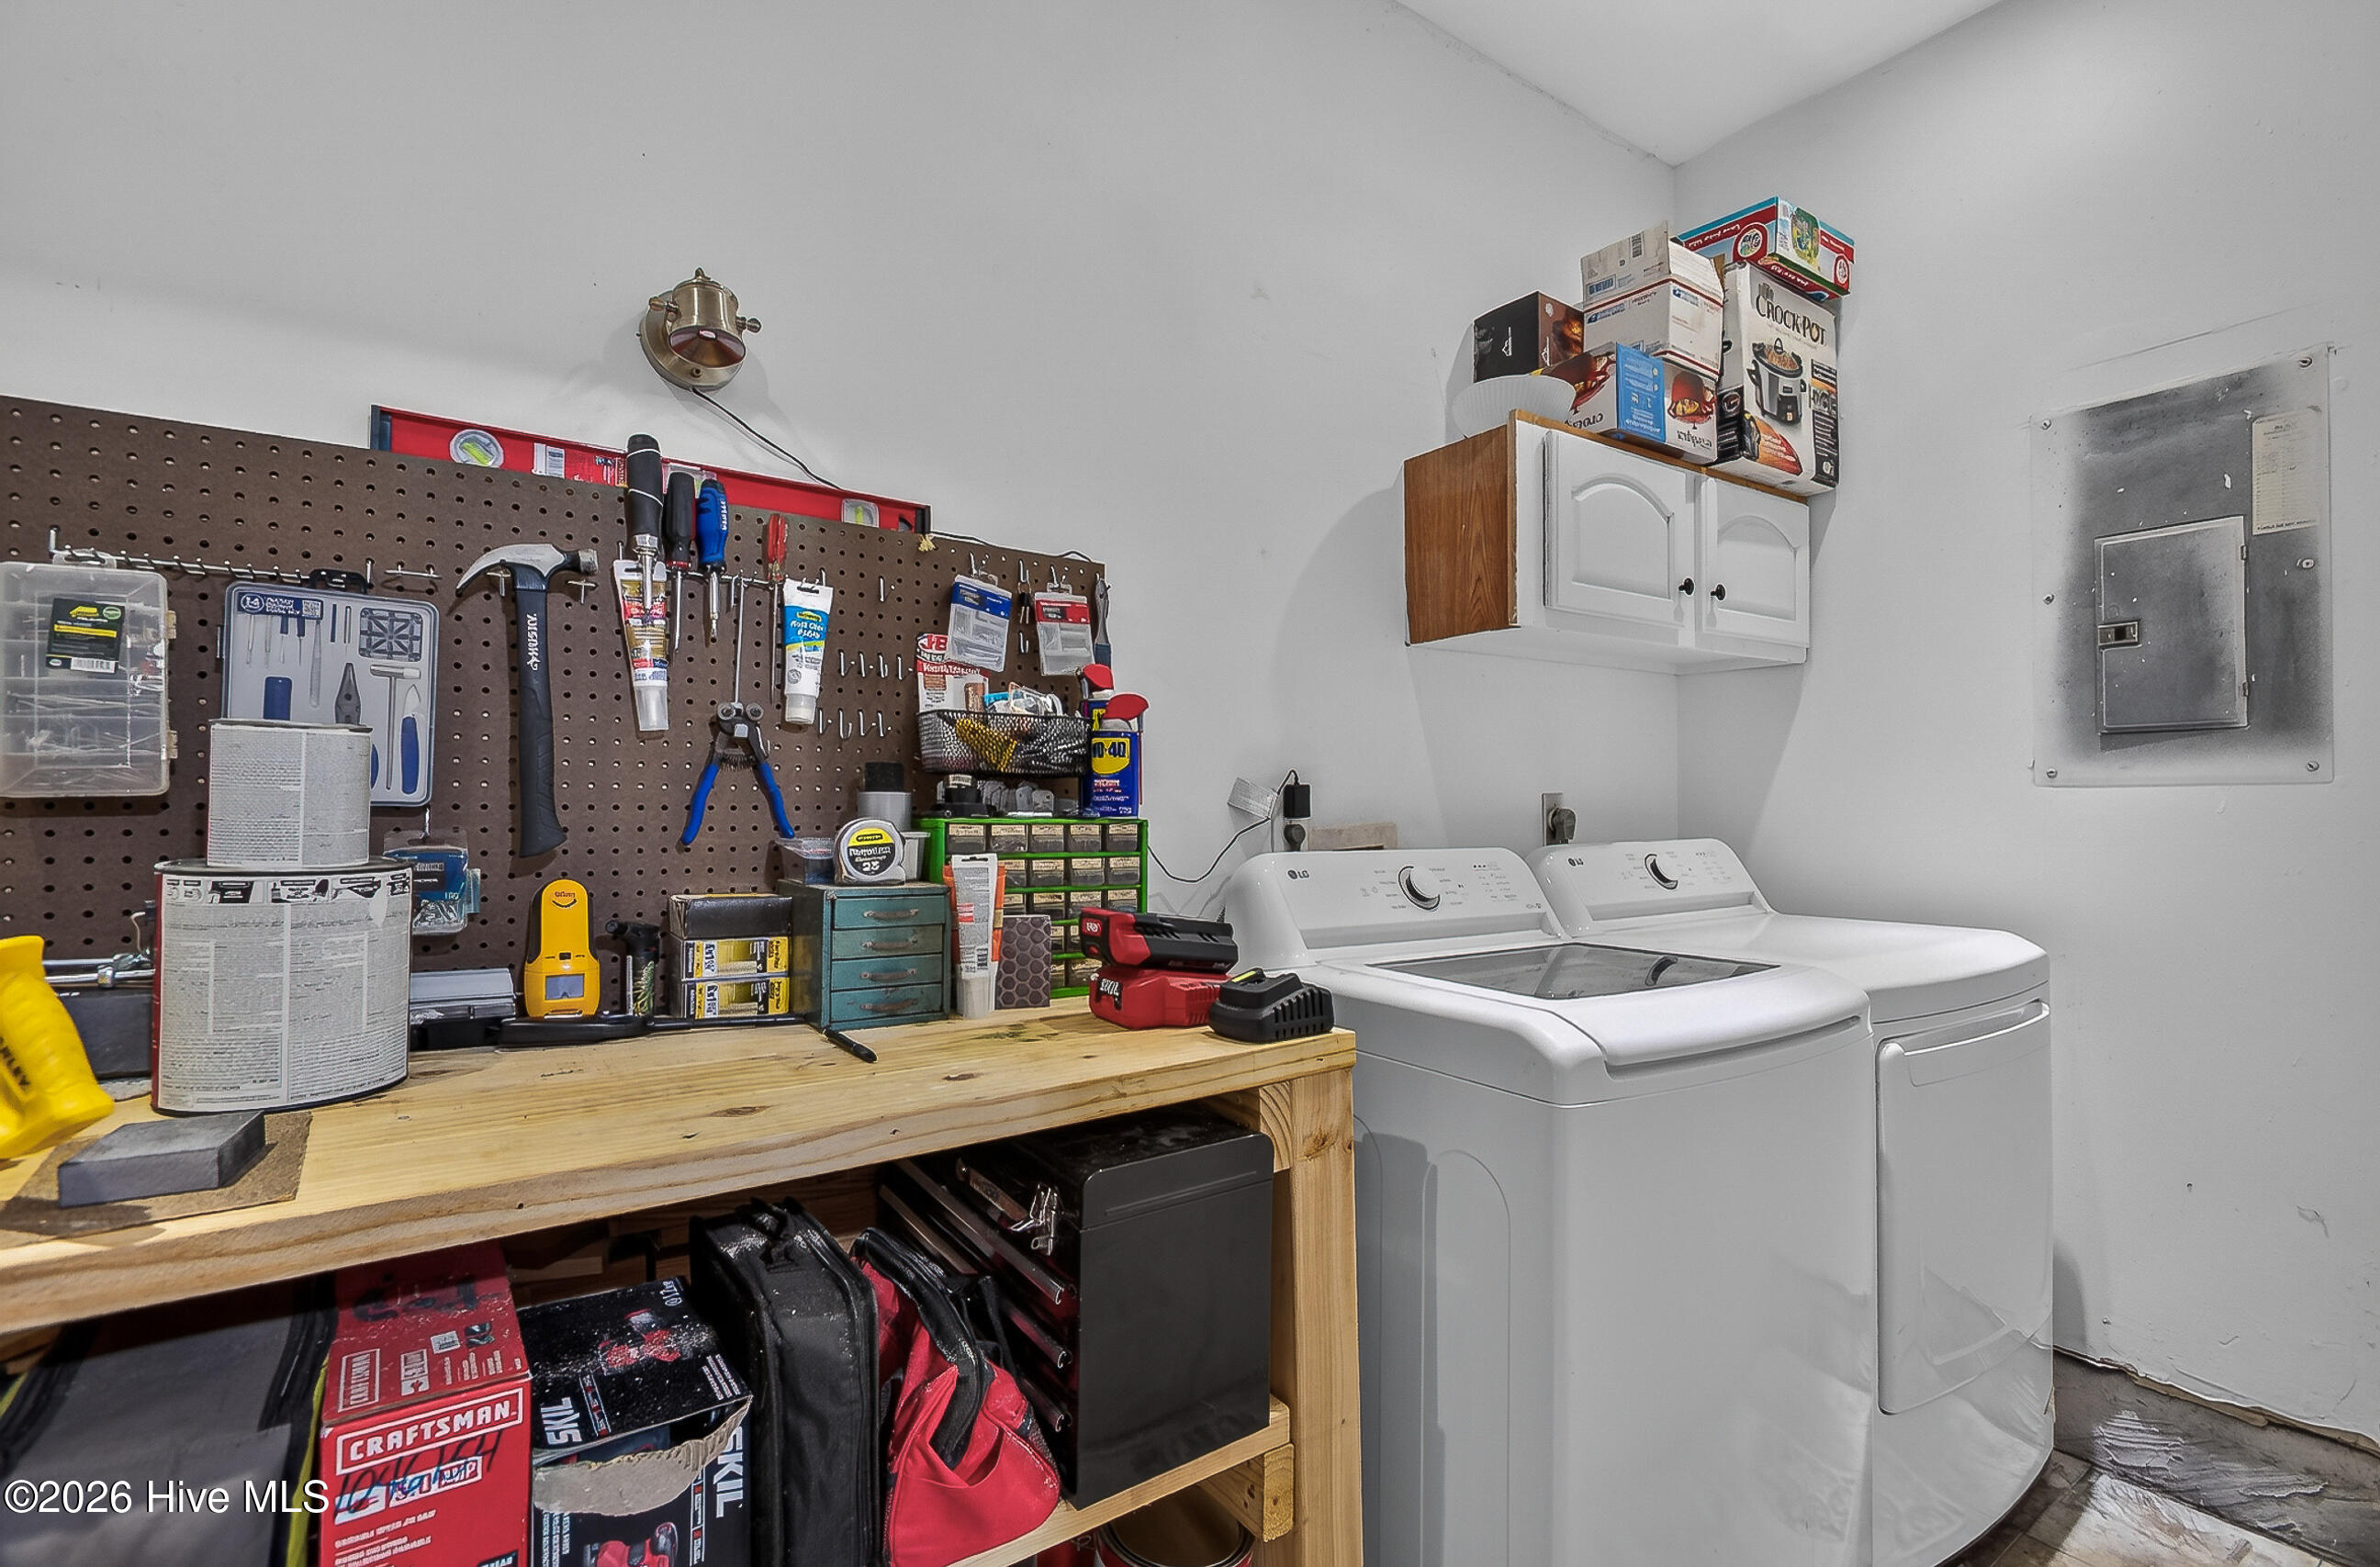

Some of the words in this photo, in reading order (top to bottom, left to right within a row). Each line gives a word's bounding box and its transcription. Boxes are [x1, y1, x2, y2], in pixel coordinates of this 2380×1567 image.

[349, 1400, 512, 1461] CRAFTSMAN
[540, 1396, 582, 1445] SKIL
[713, 1426, 745, 1518] SKIL
